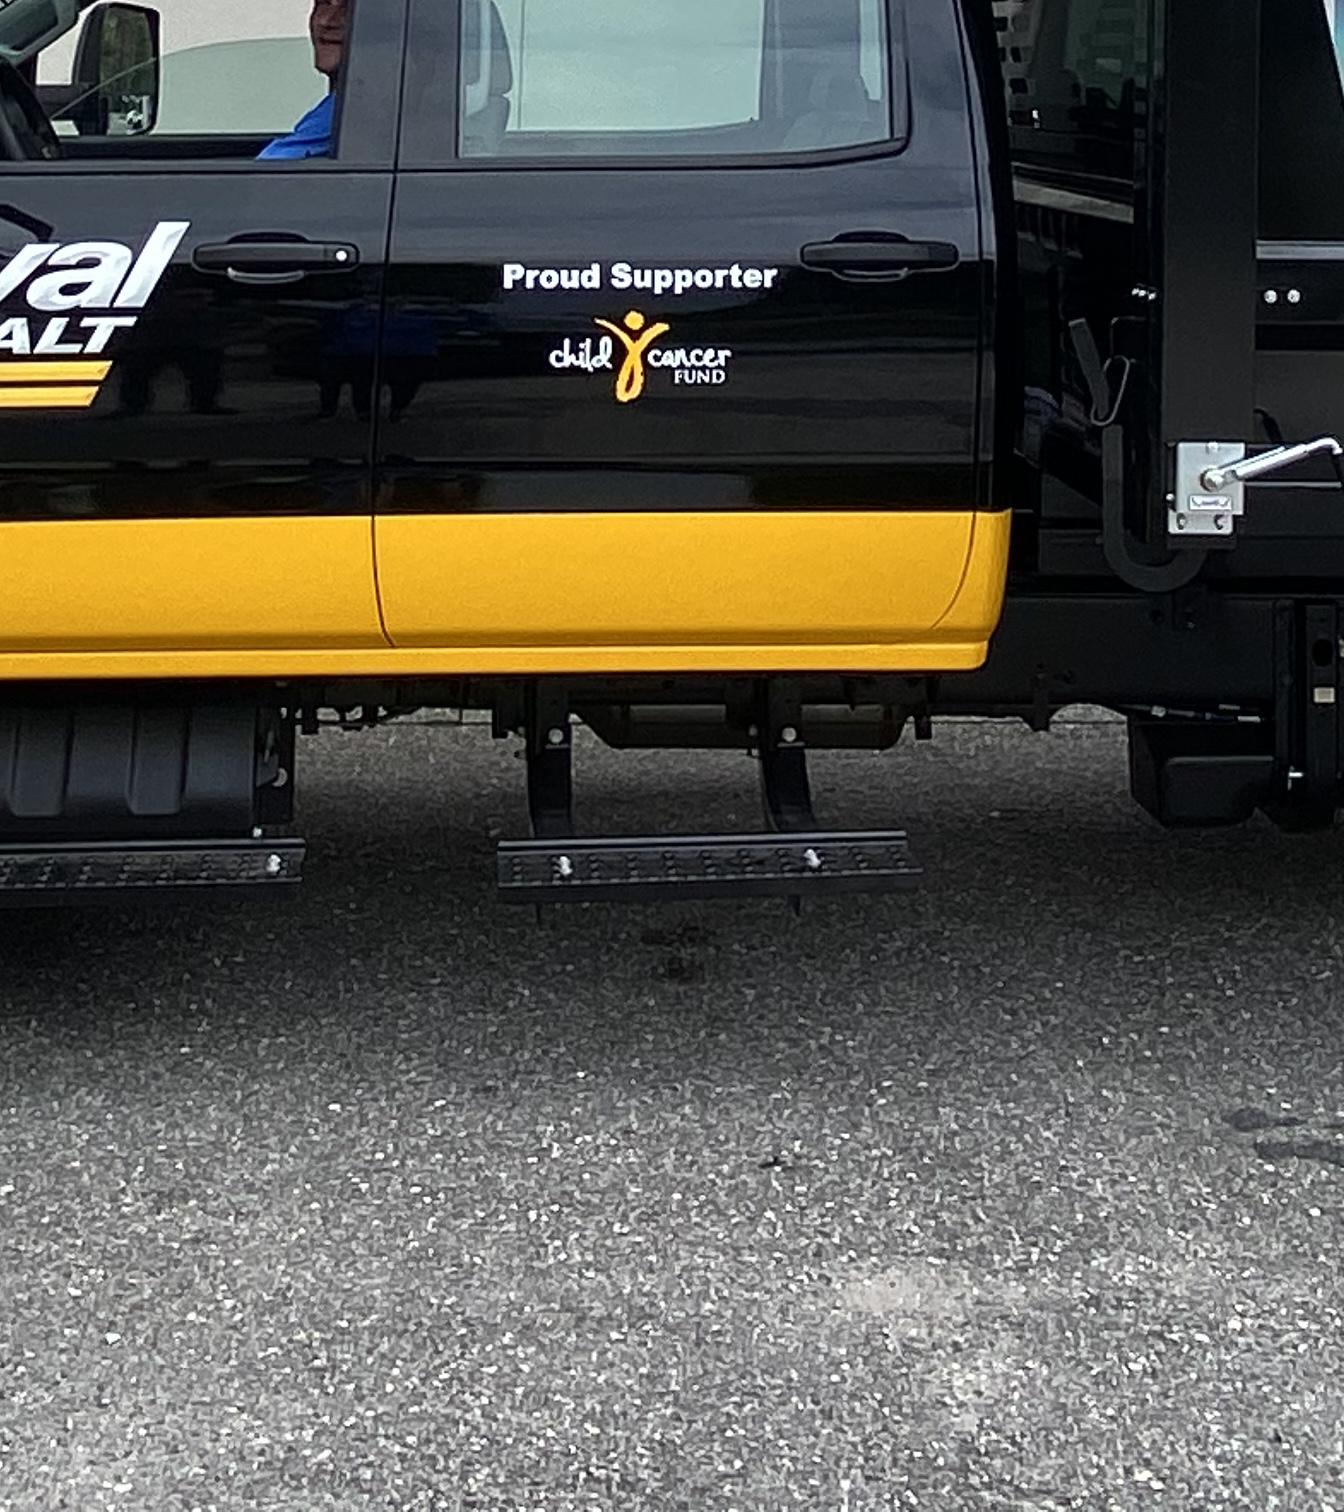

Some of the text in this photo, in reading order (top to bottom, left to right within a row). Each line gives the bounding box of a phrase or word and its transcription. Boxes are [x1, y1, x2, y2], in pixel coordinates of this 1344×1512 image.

[502, 263, 779, 295] Proud Supporter
[548, 336, 732, 373] child cancer
[674, 369, 726, 384] FUND
